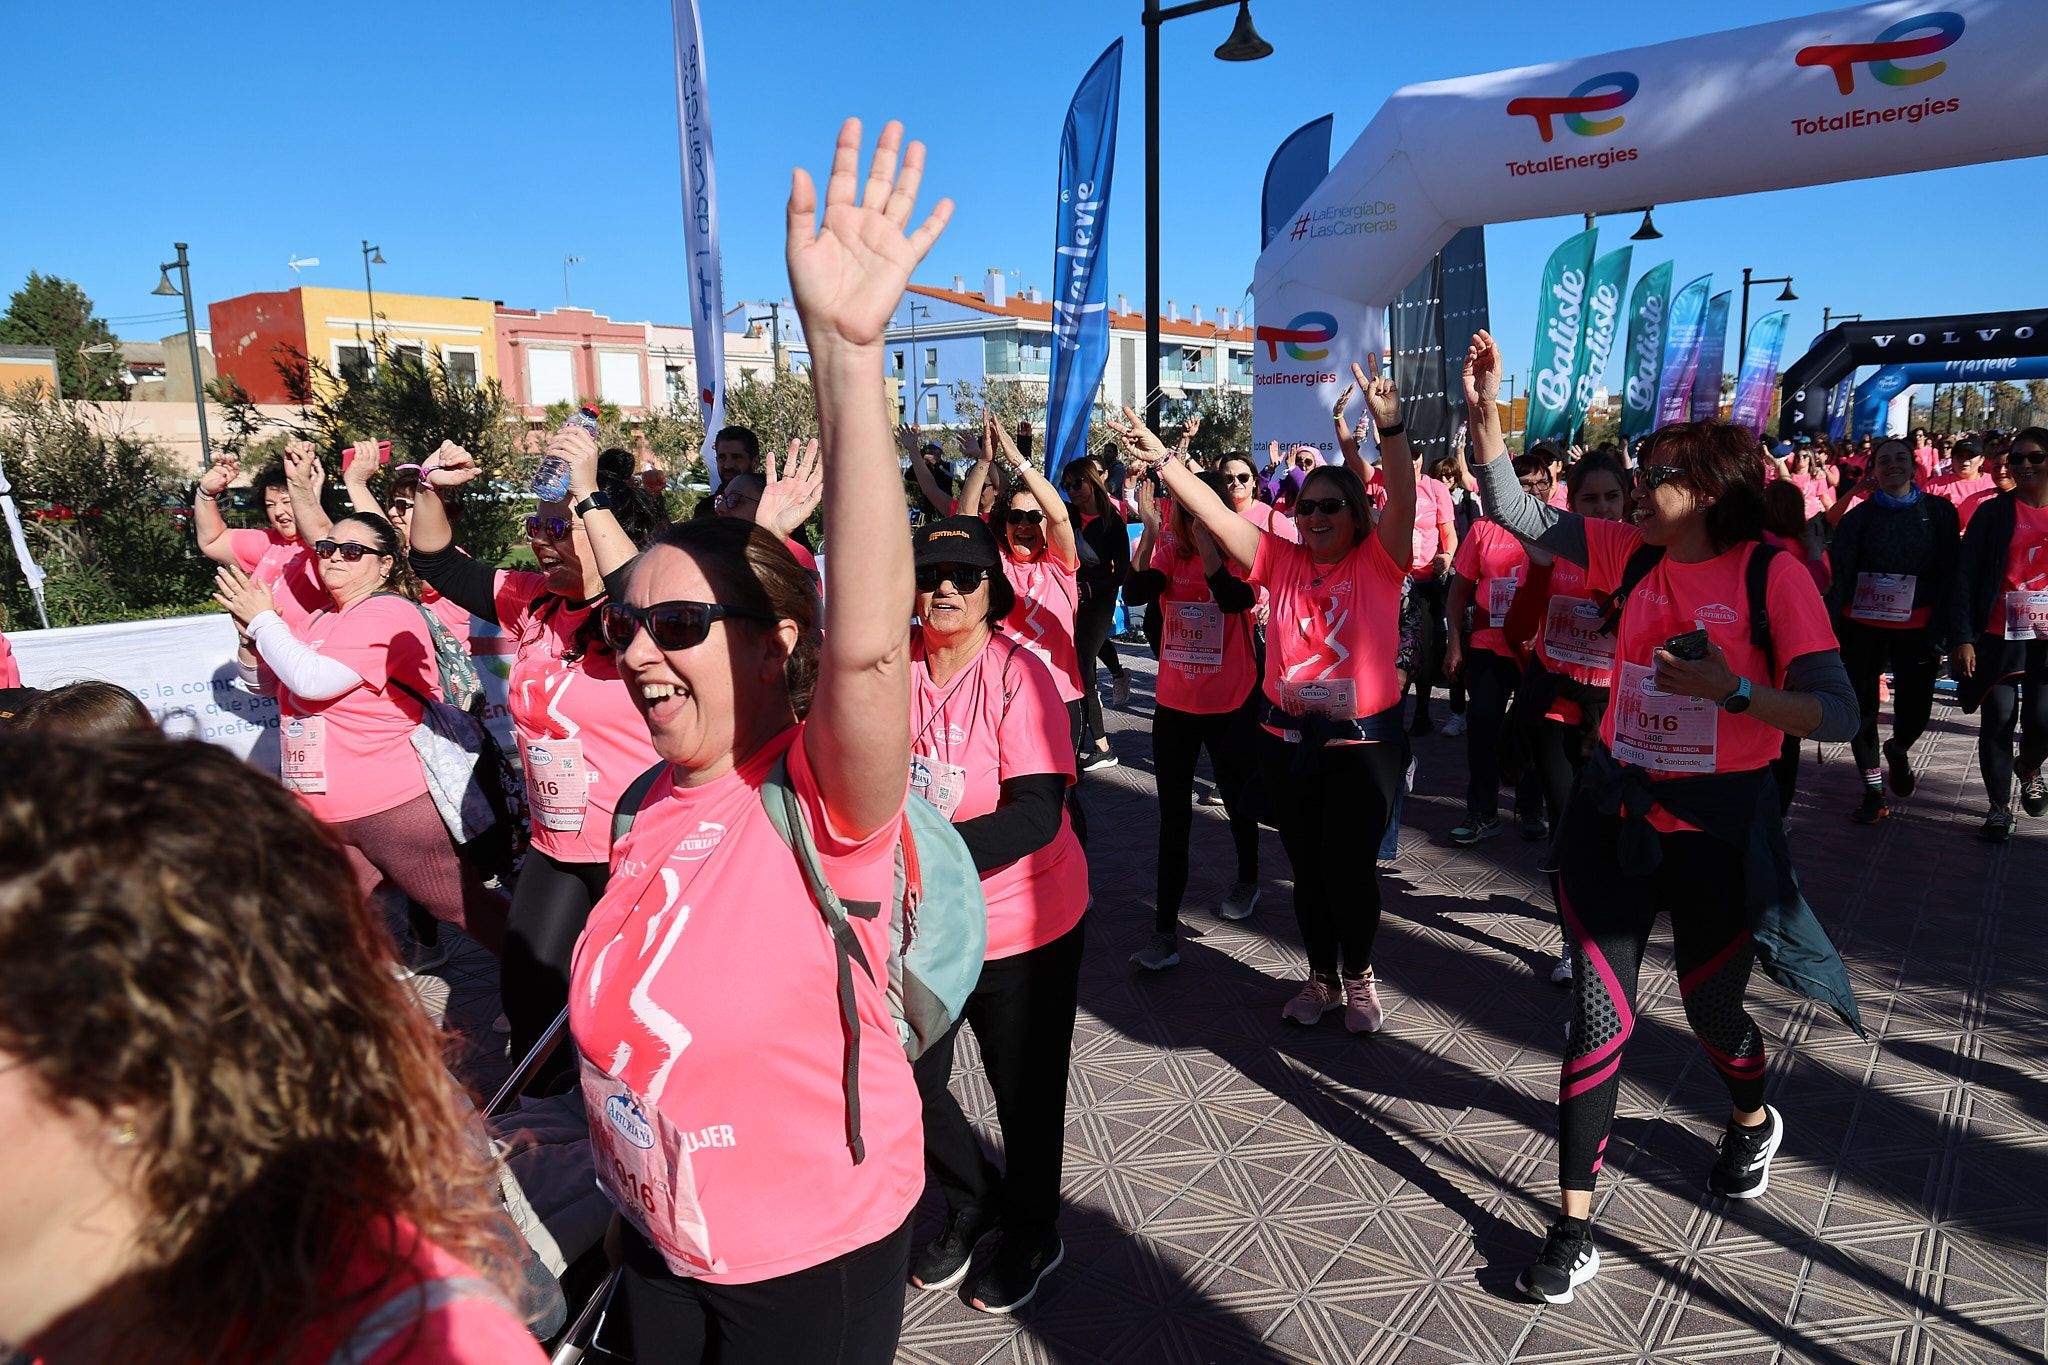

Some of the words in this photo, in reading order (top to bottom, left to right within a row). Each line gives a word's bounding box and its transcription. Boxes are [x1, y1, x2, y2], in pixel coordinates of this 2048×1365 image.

[1791, 97, 1960, 136] TotalEnergies
[1506, 147, 1638, 177] TotalEnergies
[1053, 180, 1107, 350] Marlene
[1397, 298, 1440, 309] VOLVO
[1443, 307, 1487, 318] VOLVO
[1537, 268, 1586, 411] Batiste
[1872, 326, 2034, 348] VOLVO
[1398, 345, 1442, 356] VOLVO
[1577, 283, 1619, 412] Batiste
[1627, 294, 1663, 412] Batiste
[1255, 370, 1337, 387] TotalEnergies
[1400, 391, 1444, 403] VOLVO
[1638, 589, 1669, 605] OYSHO
[1699, 609, 1736, 620] ASTURIANA
[1571, 627, 1598, 641] 016
[156, 683, 174, 697] la
[205, 700, 242, 716] que
[1638, 712, 1678, 732] 016
[1644, 733, 1663, 742] 1406
[1650, 743, 1668, 752] MUJER
[1664, 758, 1702, 767] Santander
[532, 780, 559, 796] 016
[608, 1103, 652, 1147] ASTURIANA
[615, 1158, 656, 1214] 016
